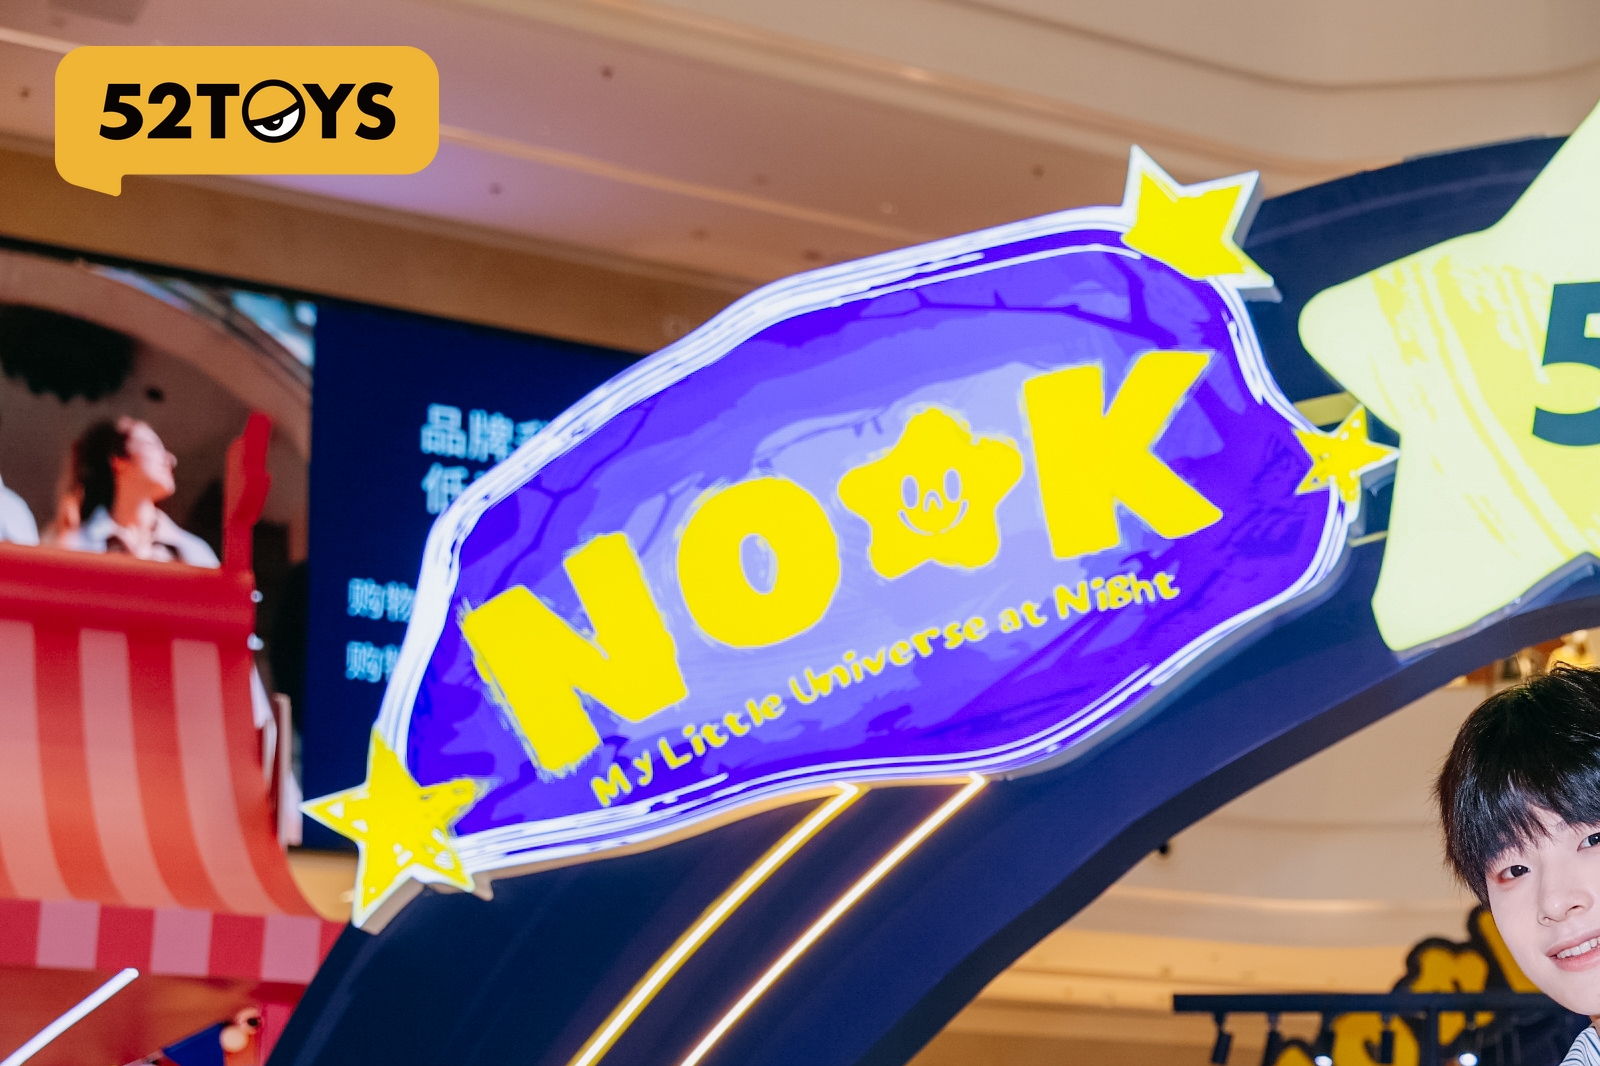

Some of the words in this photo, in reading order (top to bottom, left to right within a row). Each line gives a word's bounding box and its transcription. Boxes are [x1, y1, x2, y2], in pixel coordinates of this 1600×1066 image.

[590, 749, 654, 807] My
[658, 694, 786, 770] Little
[788, 616, 990, 705] Universe
[998, 600, 1047, 633] at
